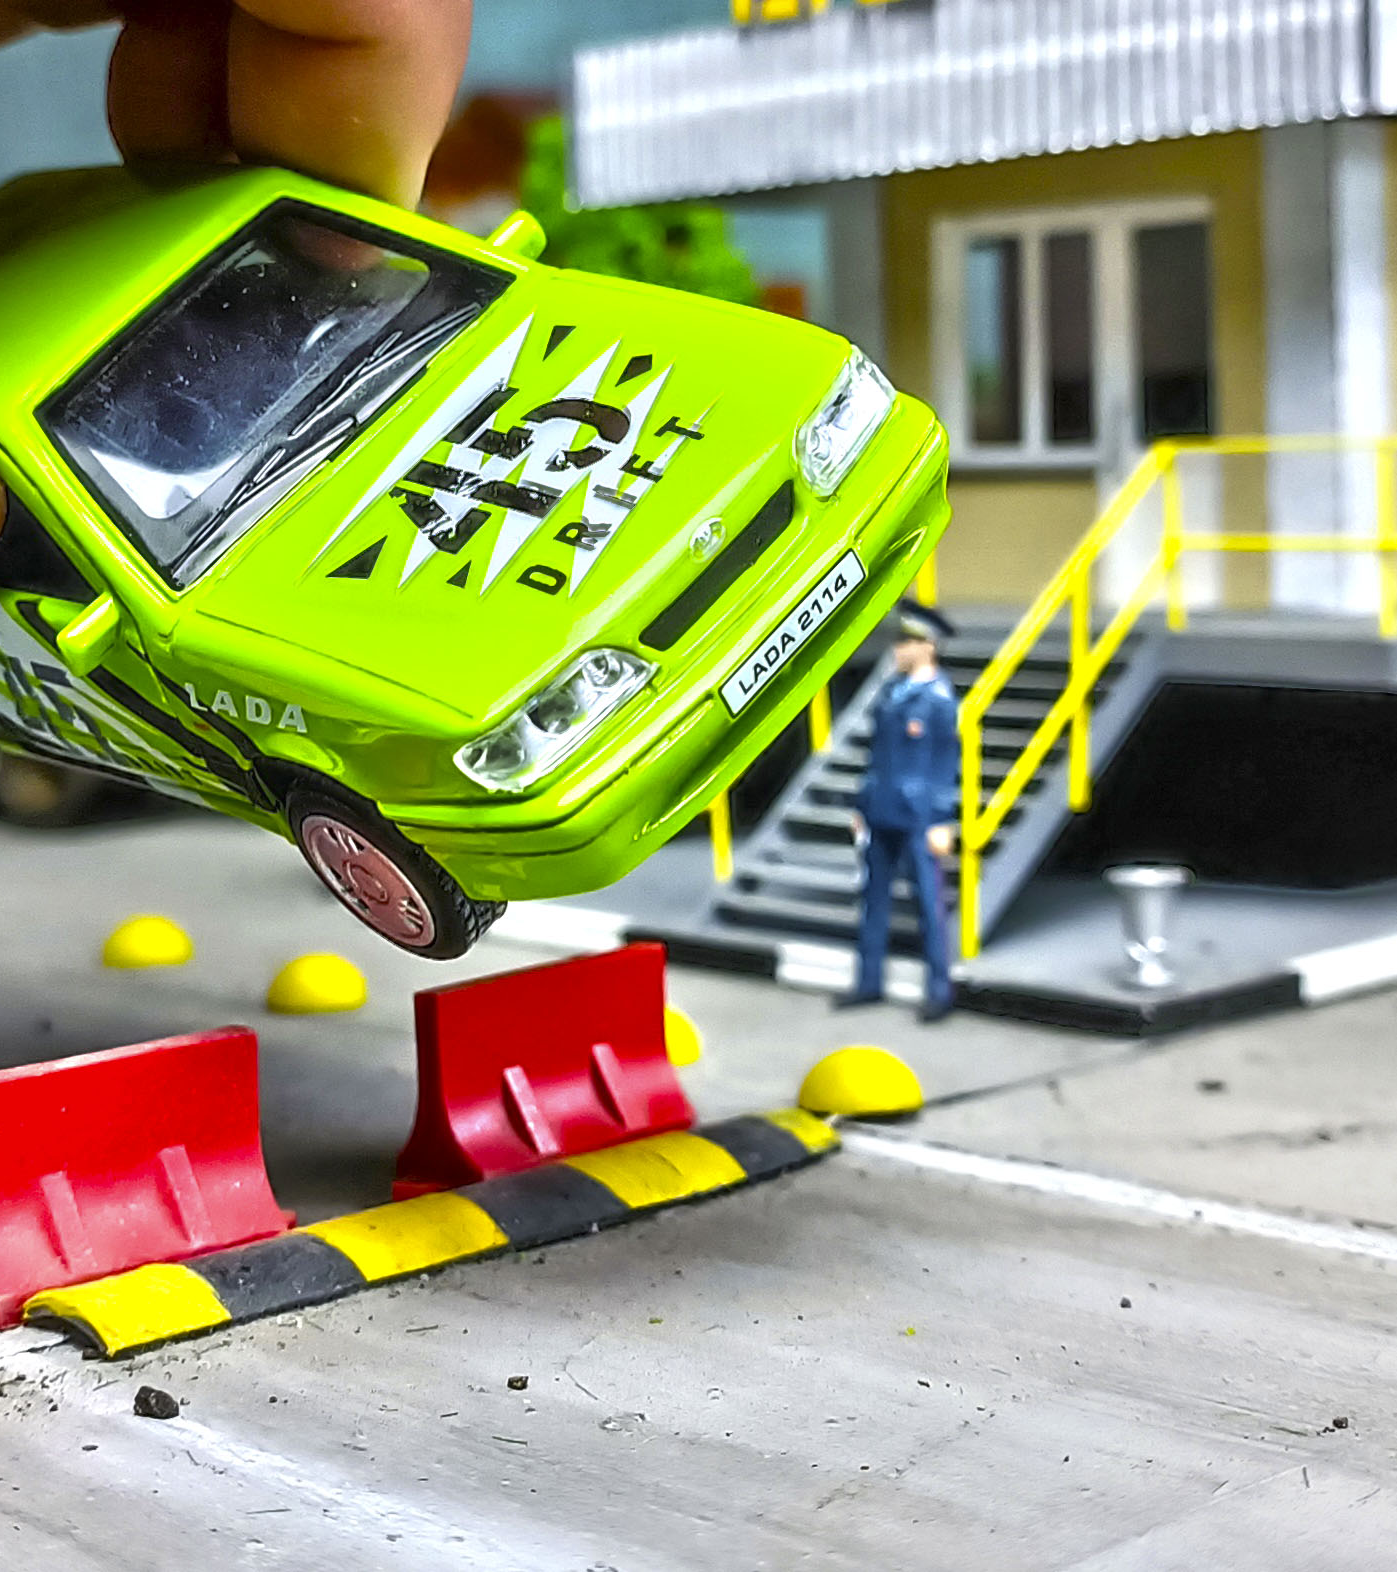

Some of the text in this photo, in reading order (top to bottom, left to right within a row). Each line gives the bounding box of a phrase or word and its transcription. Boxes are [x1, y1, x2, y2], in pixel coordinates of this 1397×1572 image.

[388, 380, 632, 555] 45
[516, 415, 705, 596] DRIFT
[184, 682, 308, 734] LADA
[737, 572, 848, 695] LADA 2114
